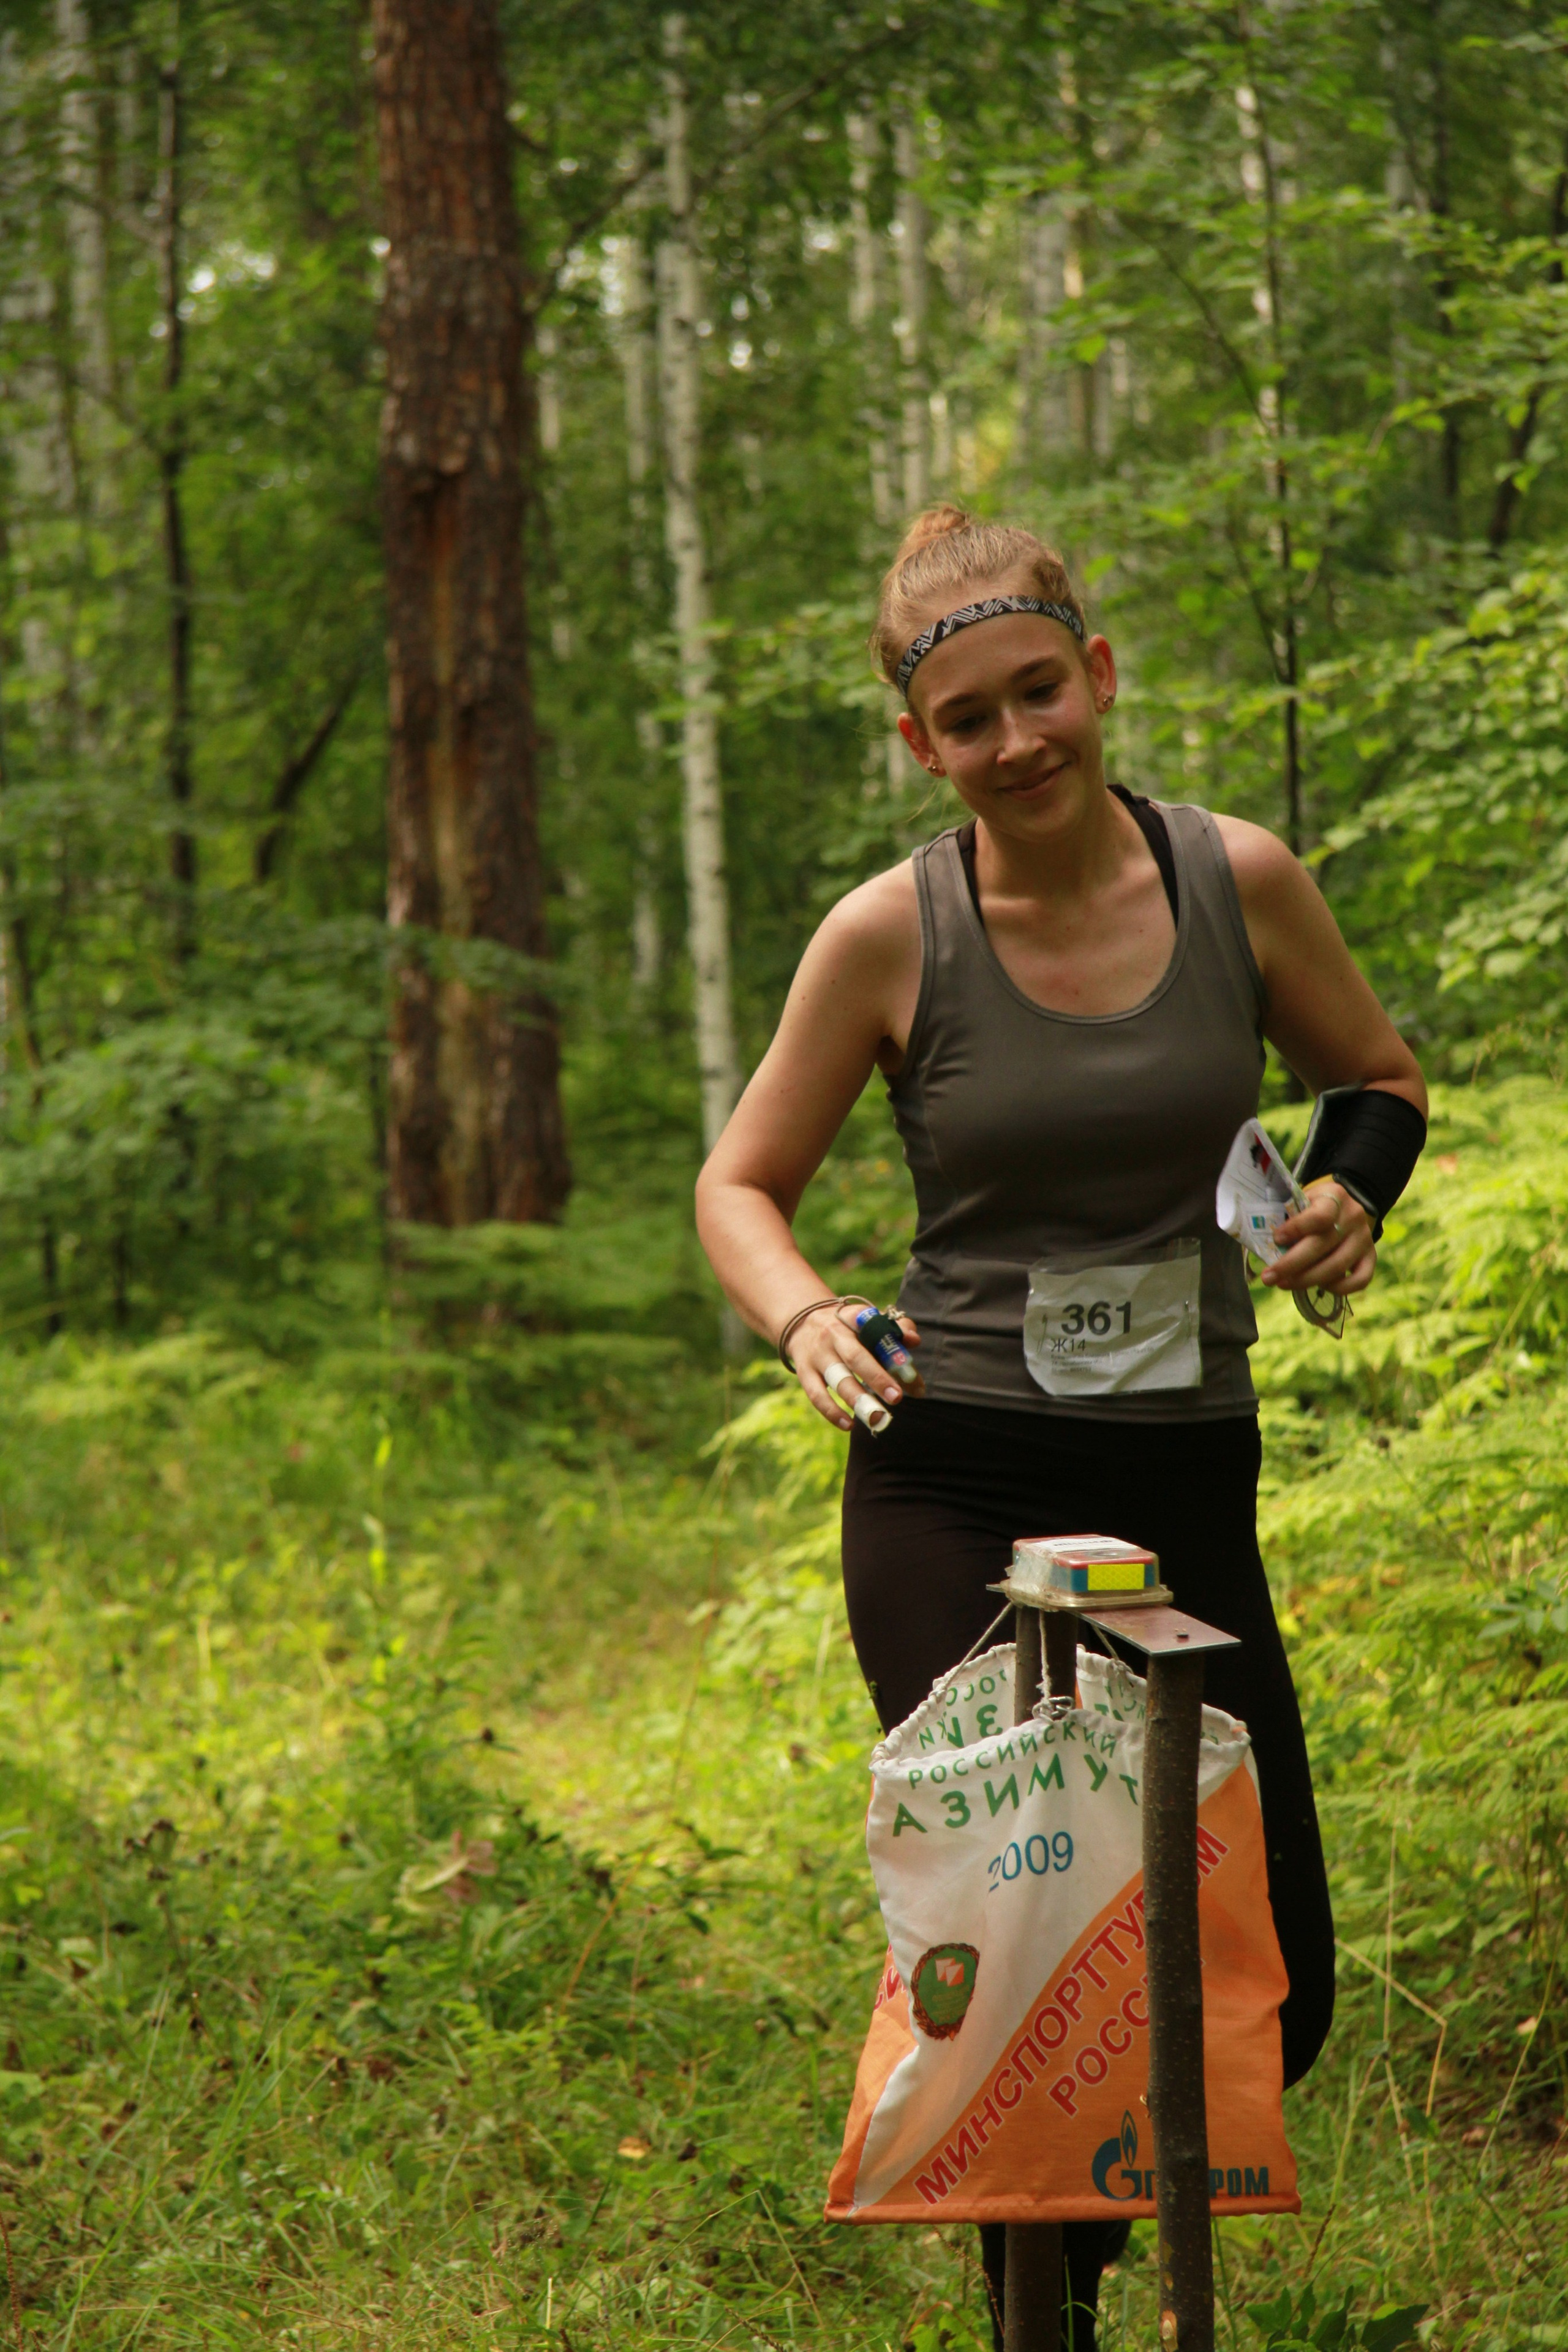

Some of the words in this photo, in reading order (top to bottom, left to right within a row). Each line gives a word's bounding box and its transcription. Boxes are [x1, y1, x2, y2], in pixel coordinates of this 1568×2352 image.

[1050, 1338, 1086, 1353] Ж14
[1061, 1300, 1132, 1335] 361
[908, 1721, 1117, 1790] РОССИЙСКИЙ
[892, 1752, 1139, 1837] АЗИМУТ
[987, 1831, 1074, 1893] 2009
[913, 1823, 1230, 2206] МИНСПОРТТУМ
